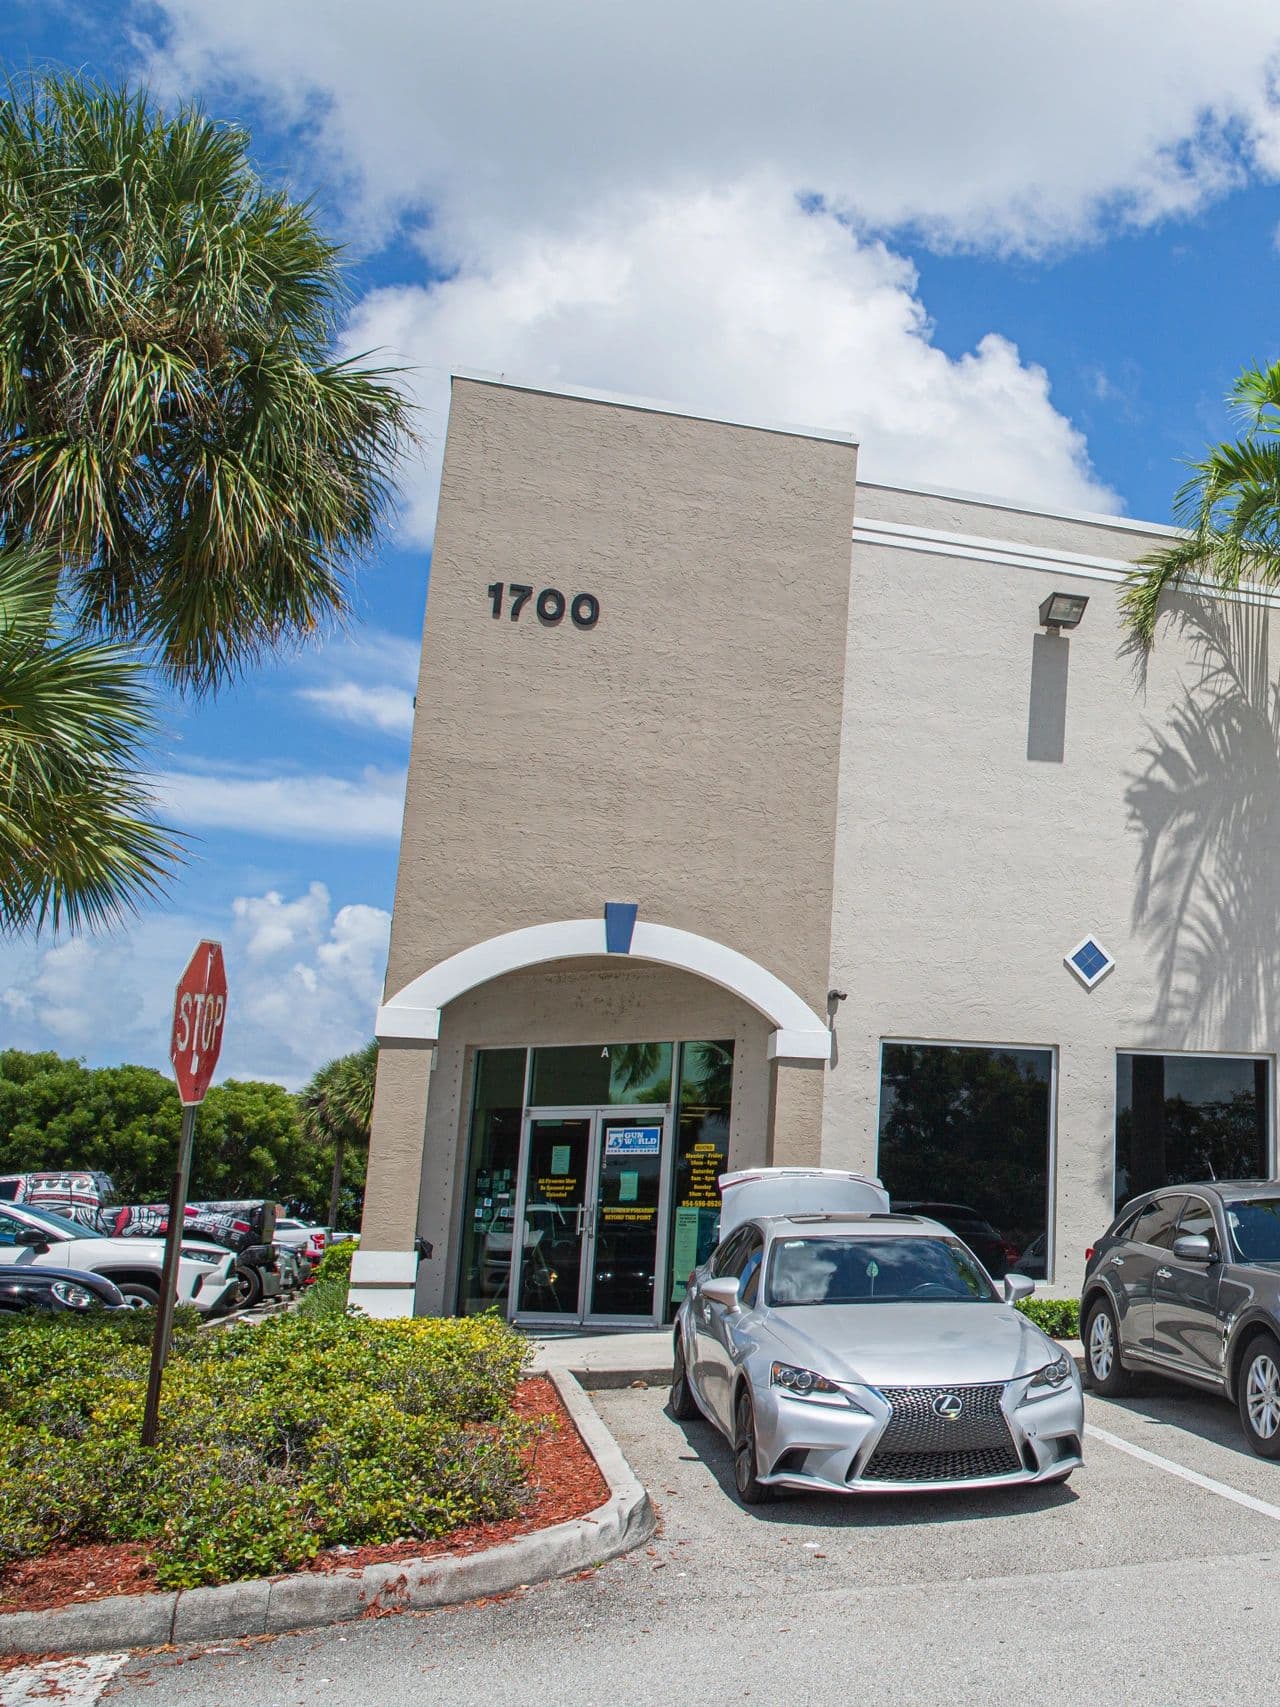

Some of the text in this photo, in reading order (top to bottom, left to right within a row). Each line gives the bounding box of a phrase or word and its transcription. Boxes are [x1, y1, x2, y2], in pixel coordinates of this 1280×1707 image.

[487, 581, 600, 626] 1700
[176, 991, 225, 1052] STOP
[600, 1046, 609, 1058] A
